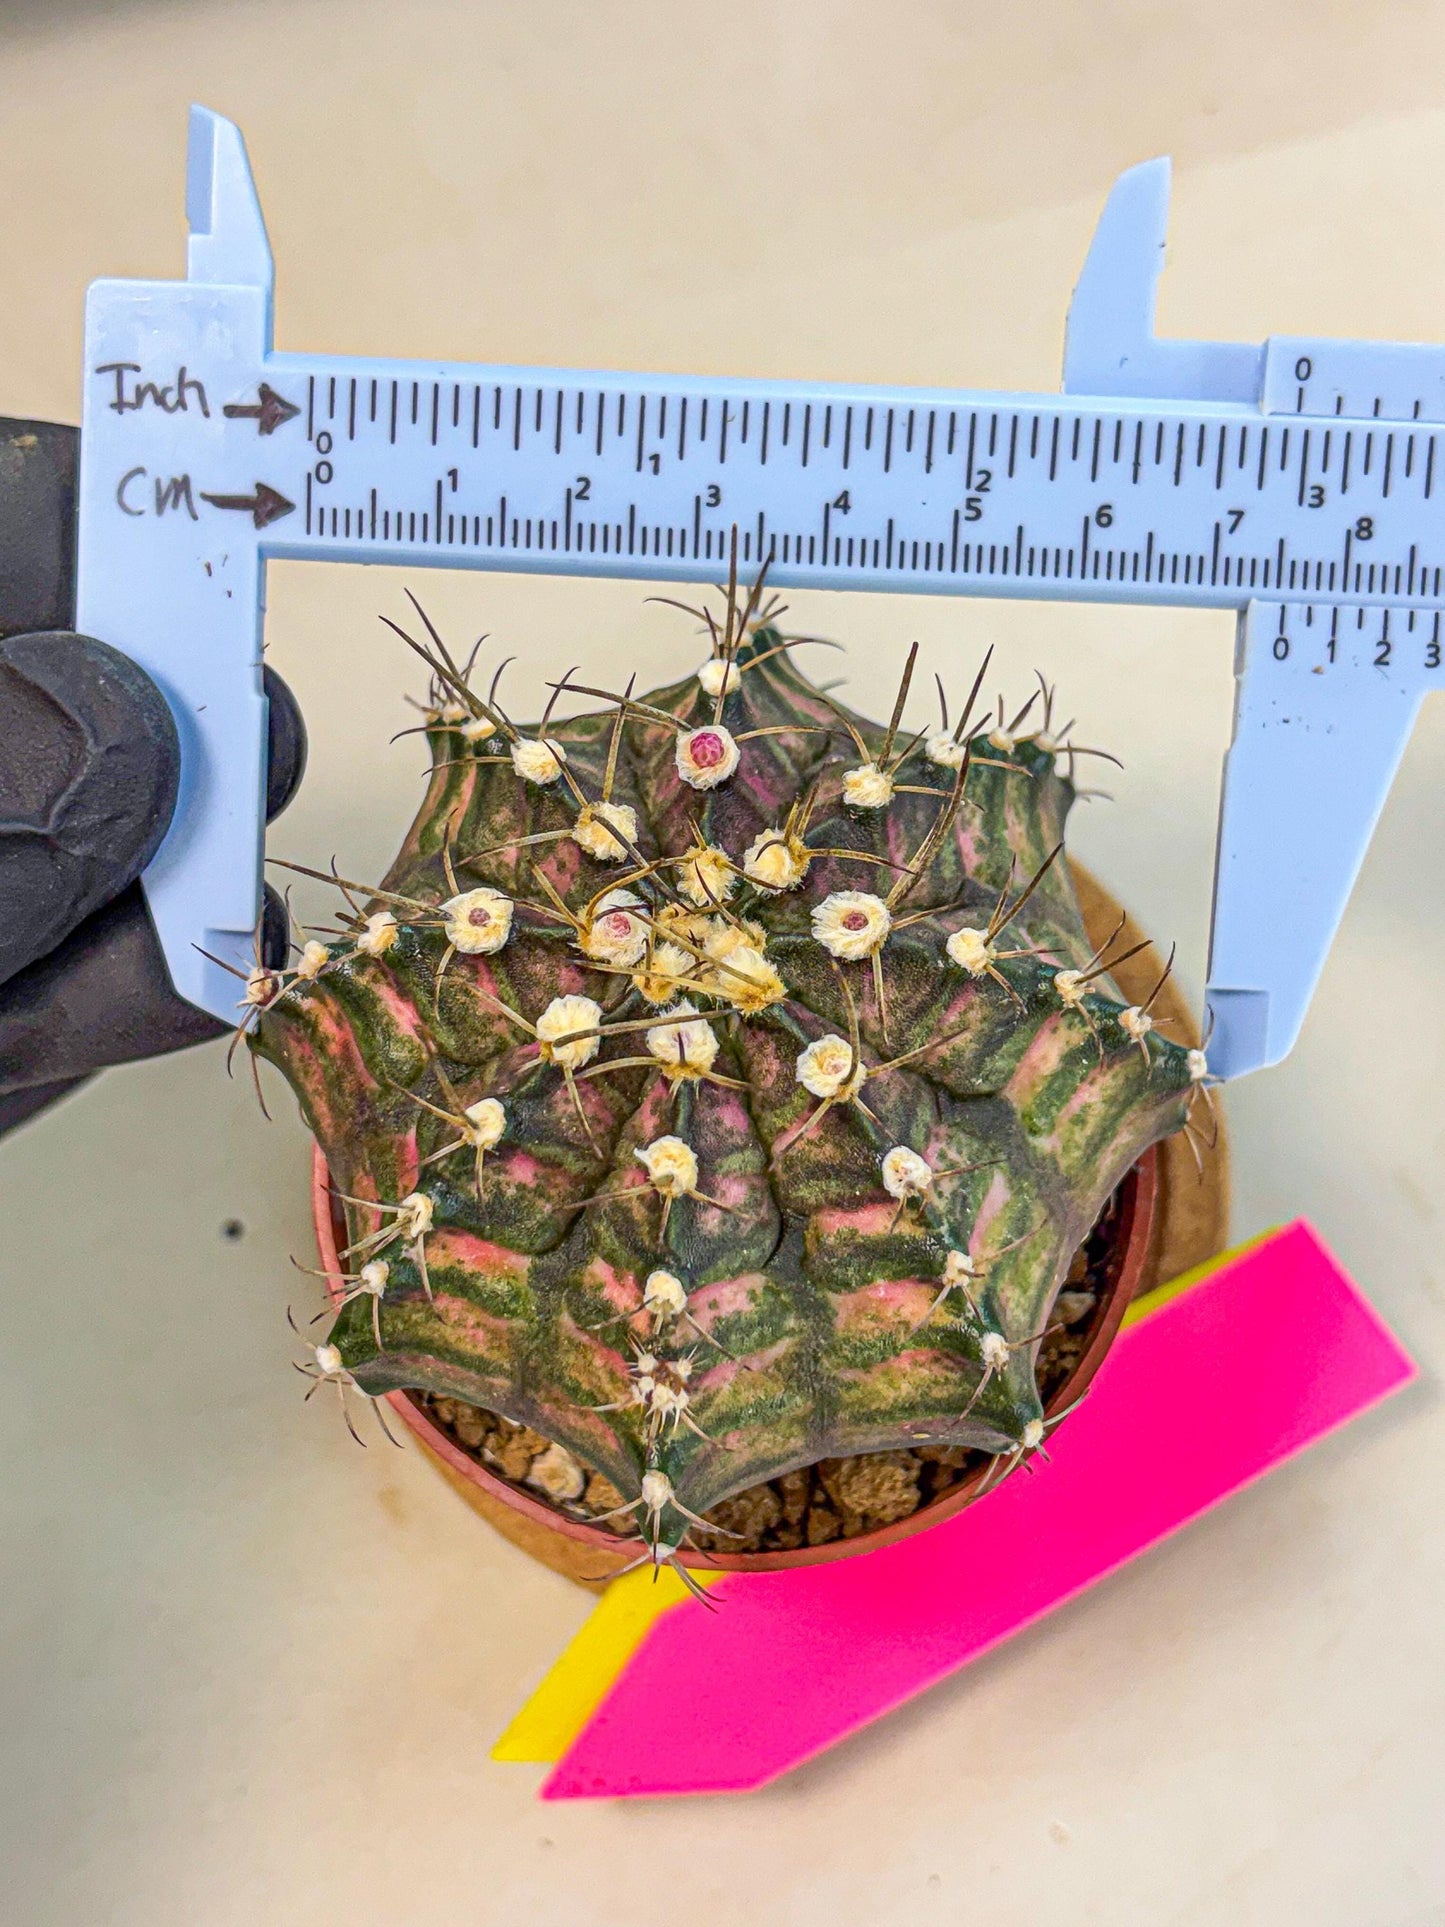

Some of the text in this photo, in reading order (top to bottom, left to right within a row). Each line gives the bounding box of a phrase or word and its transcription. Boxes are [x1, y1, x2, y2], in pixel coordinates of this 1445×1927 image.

[95, 363, 210, 418] Inch
[1295, 357, 1312, 381] 0
[316, 431, 1325, 509] 0 1 2 3
[315, 461, 1374, 541] 0 1 2 3 4 5 6 7 8
[1273, 637, 1441, 668] 0 1 2 3
